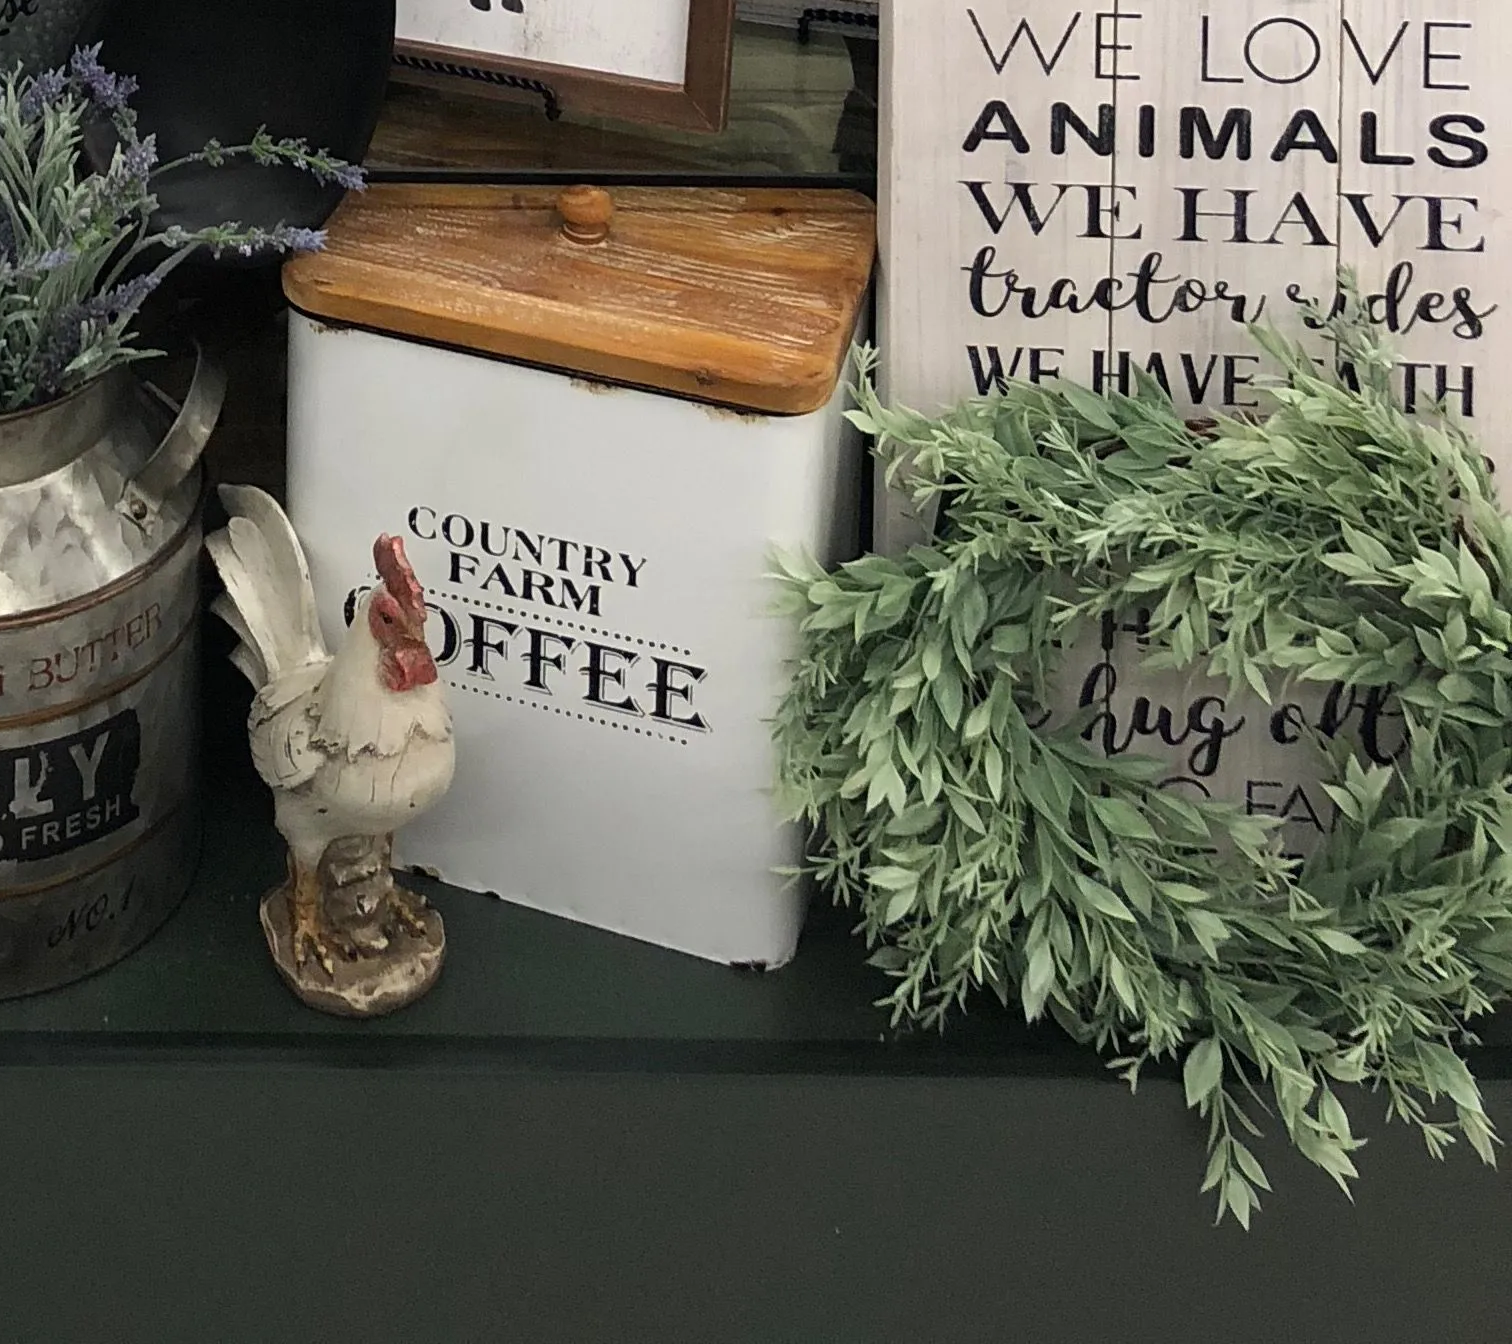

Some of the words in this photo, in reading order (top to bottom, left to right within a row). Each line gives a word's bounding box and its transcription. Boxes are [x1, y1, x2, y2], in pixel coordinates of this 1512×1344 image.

[966, 8, 1142, 82] WE
[1201, 14, 1473, 91] LOVE
[962, 99, 1489, 169] ANIMALS
[958, 180, 1144, 240] WE
[1173, 187, 1486, 254] HAVE
[961, 246, 1266, 325] tractor
[407, 505, 647, 588] COUNTRY
[447, 550, 604, 617] FARM
[28, 601, 164, 691] BUTTER
[1079, 662, 1246, 778] hug
[20, 795, 122, 850] FRESH
